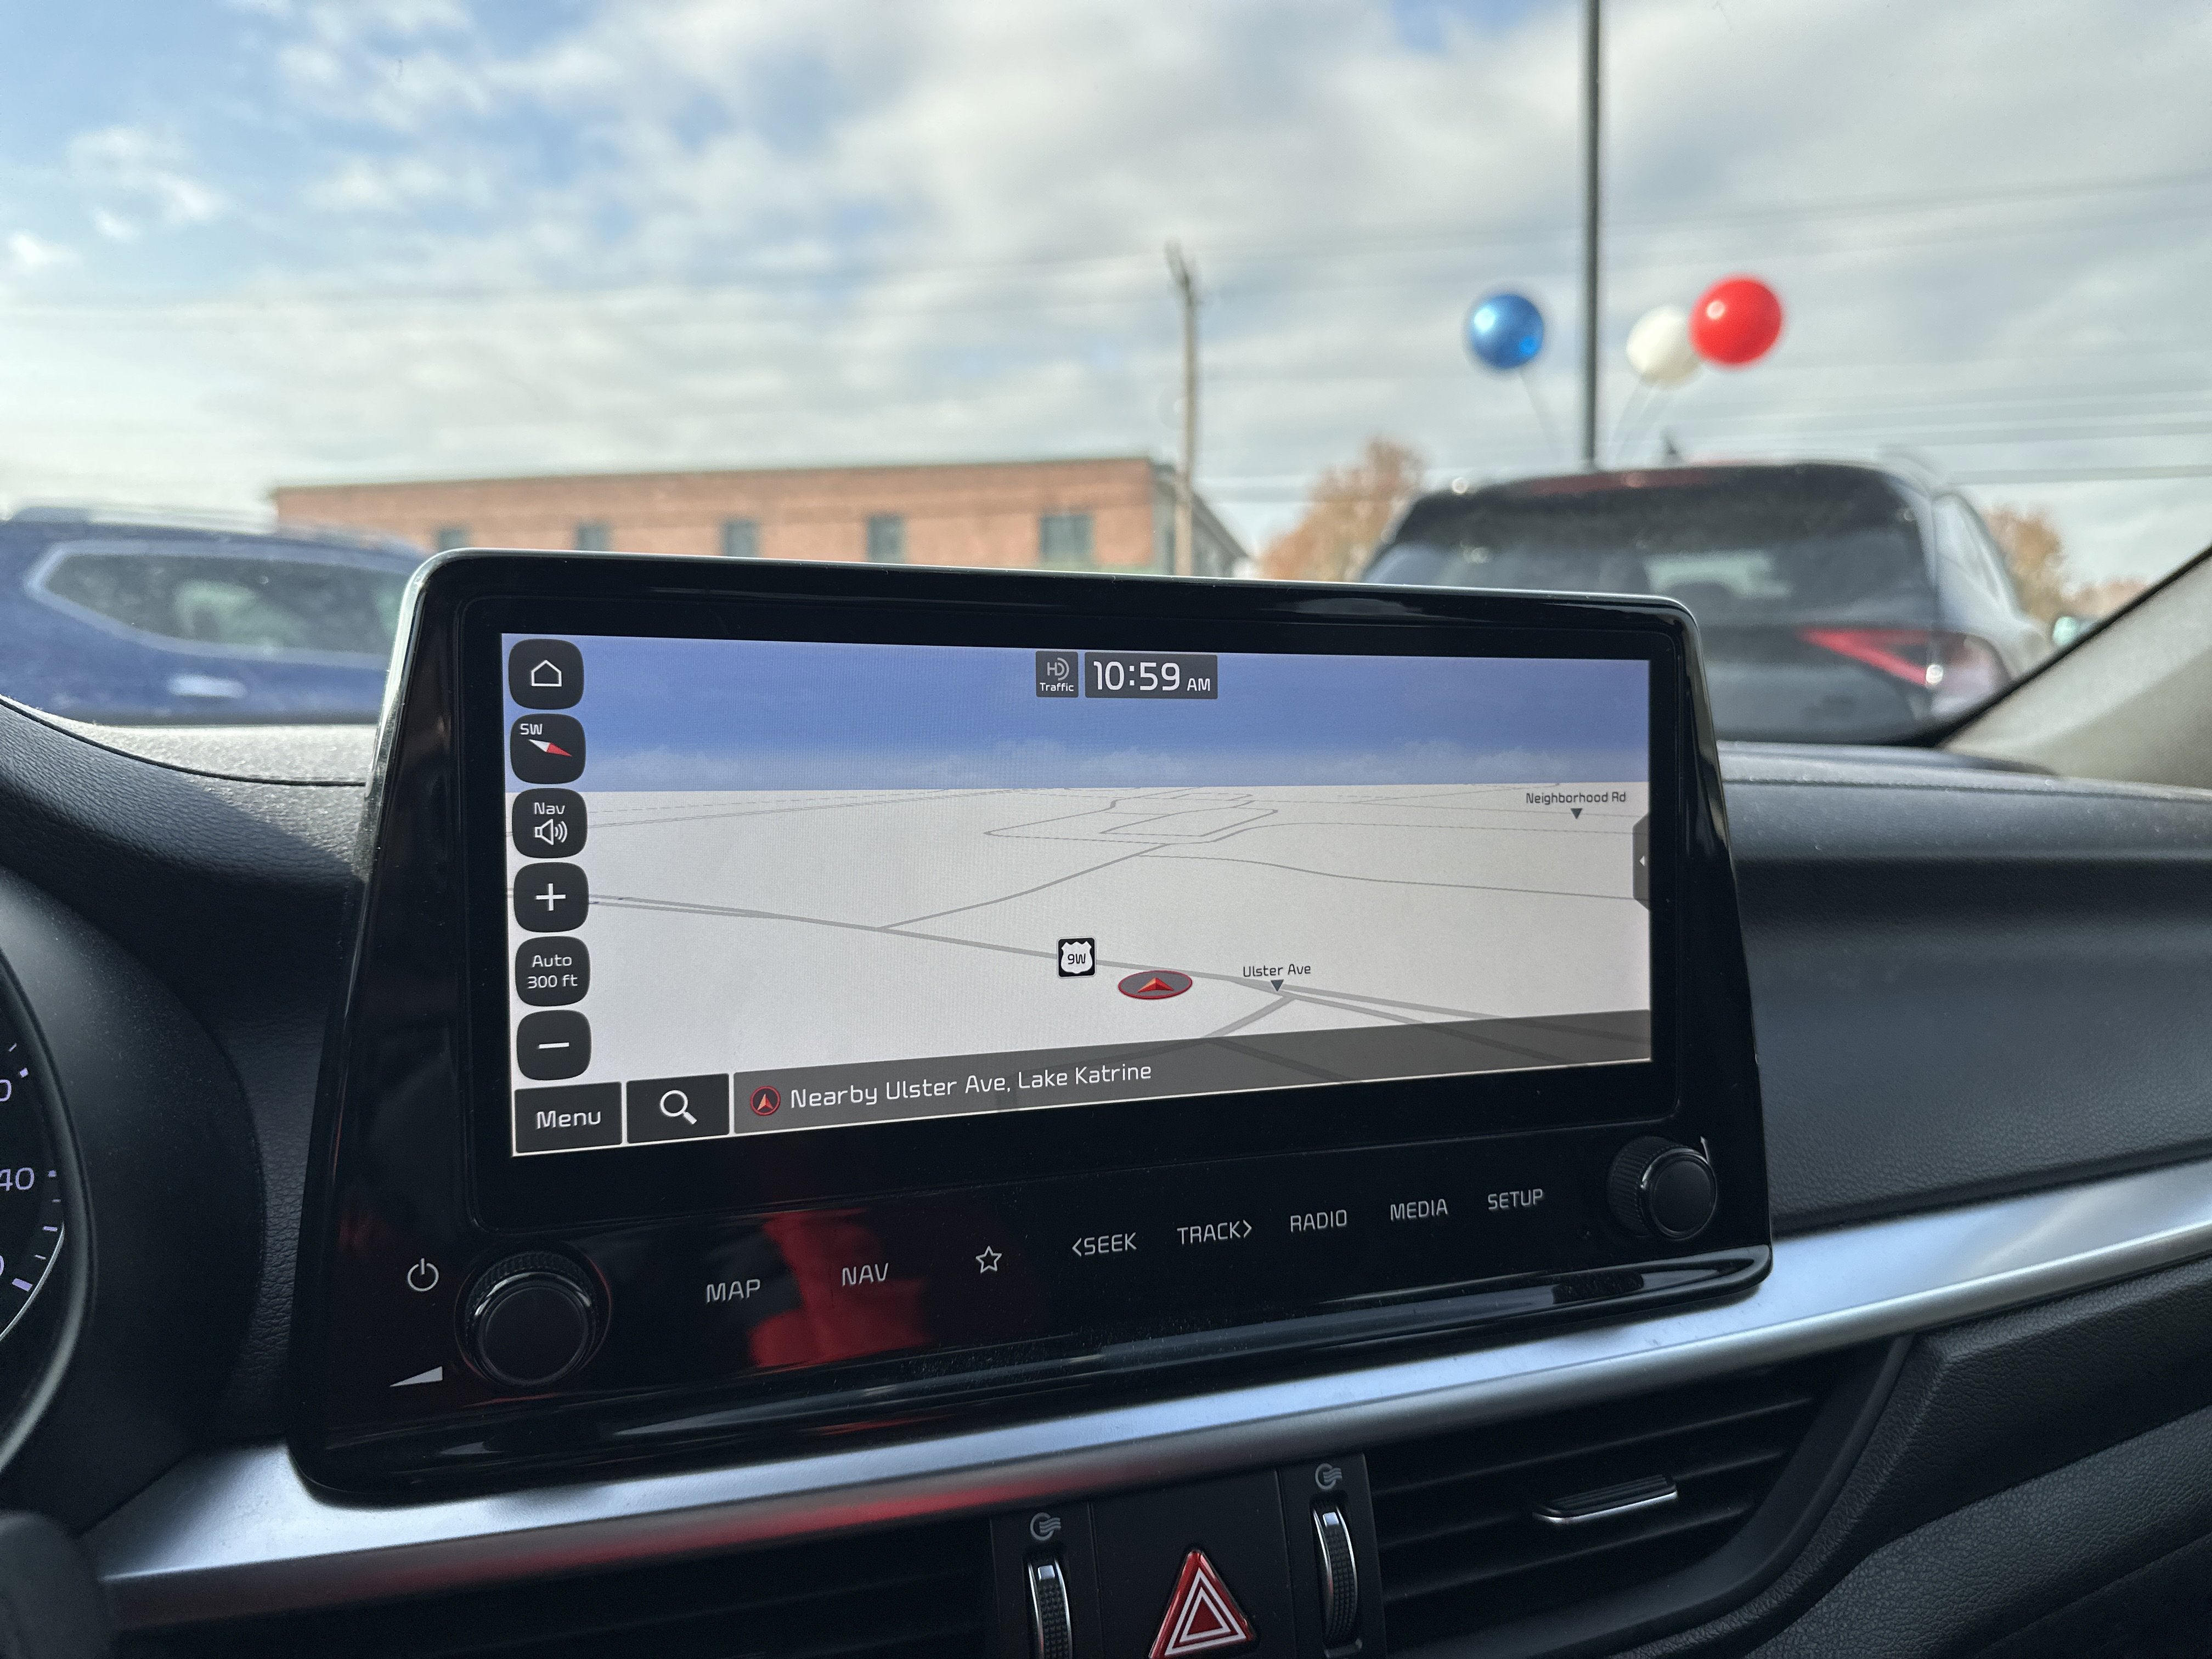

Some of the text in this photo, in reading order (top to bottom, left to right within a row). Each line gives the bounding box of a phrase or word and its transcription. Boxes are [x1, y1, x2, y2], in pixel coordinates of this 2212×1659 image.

[1093, 661, 1210, 691] 10:59 AM
[1039, 682, 1074, 692] Traffic
[520, 723, 543, 735] SW
[1526, 791, 1626, 805] Neighborhood Rd
[534, 802, 566, 815] Nav
[532, 954, 572, 968] Auto
[1066, 952, 1087, 966] 9W
[1243, 963, 1311, 978] Ulster Ave
[528, 974, 578, 989] 300 ft
[791, 1063, 1152, 1108] Nearby Ulster Ave, Lake Katrine
[537, 1110, 601, 1129] Menu
[1487, 1188, 1543, 1210] SETUP
[1390, 1199, 1448, 1221] MEDIA
[1290, 1209, 1347, 1232] RADIO
[842, 1262, 889, 1286] NAV
[707, 1279, 760, 1303] MAP
